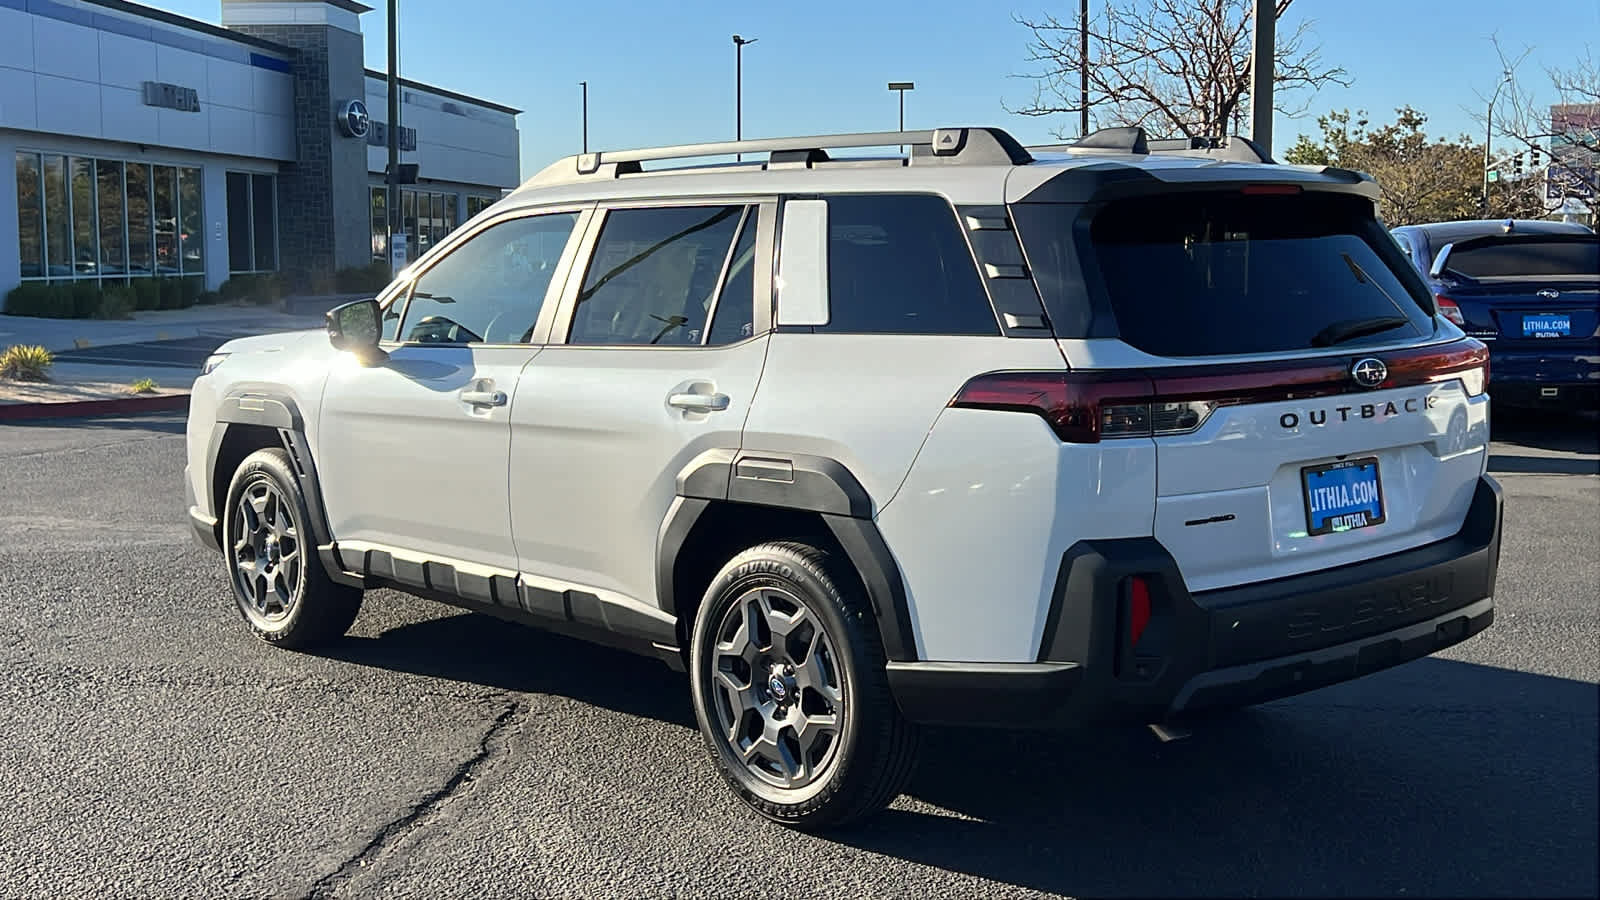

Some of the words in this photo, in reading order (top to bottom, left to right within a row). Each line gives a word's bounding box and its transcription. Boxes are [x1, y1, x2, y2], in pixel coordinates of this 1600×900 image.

[1522, 320, 1570, 331] LITHIA.COM
[1279, 396, 1439, 429] OUTBACK
[1309, 479, 1379, 513] LITHIA.COM
[1340, 512, 1368, 530] LITHIA
